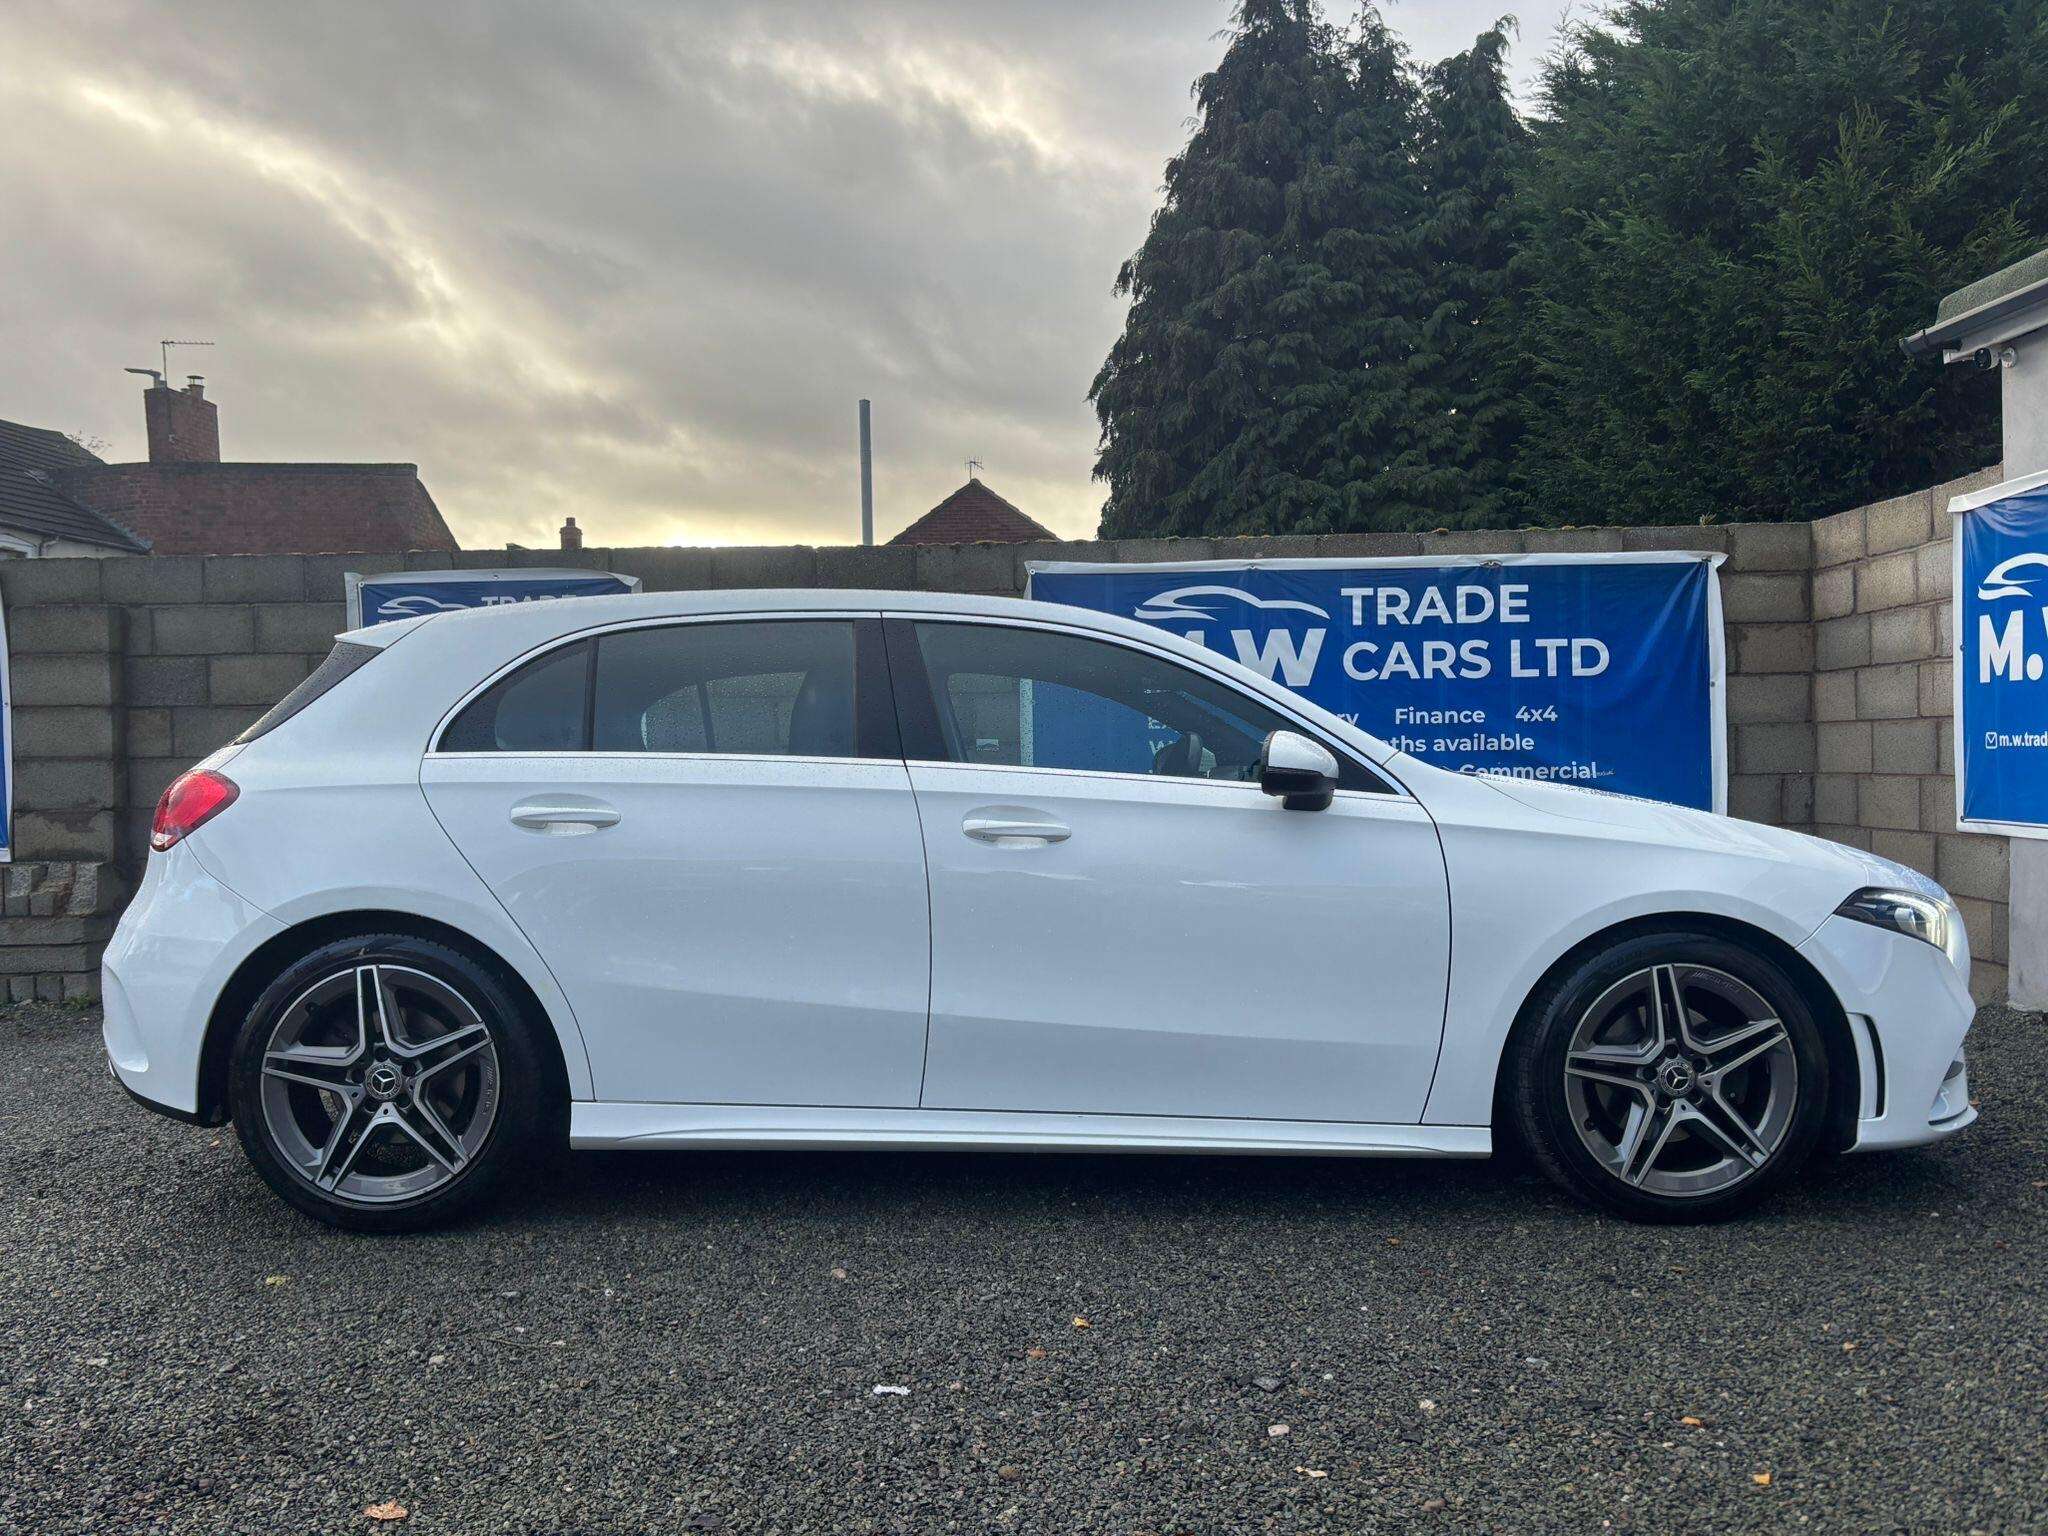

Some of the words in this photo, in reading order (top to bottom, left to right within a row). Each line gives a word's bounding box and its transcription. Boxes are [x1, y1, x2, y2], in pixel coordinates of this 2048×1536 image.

[1340, 584, 1530, 626] TRADE
[1342, 639, 1492, 681] CARS
[1510, 637, 1610, 678] LTD
[1979, 607, 2048, 683] M.
[1394, 706, 1486, 725] Finance
[1515, 705, 1559, 723] 4x4
[1381, 734, 1428, 753] ths
[1433, 733, 1535, 752] available
[1999, 730, 2048, 747] m.w.trad
